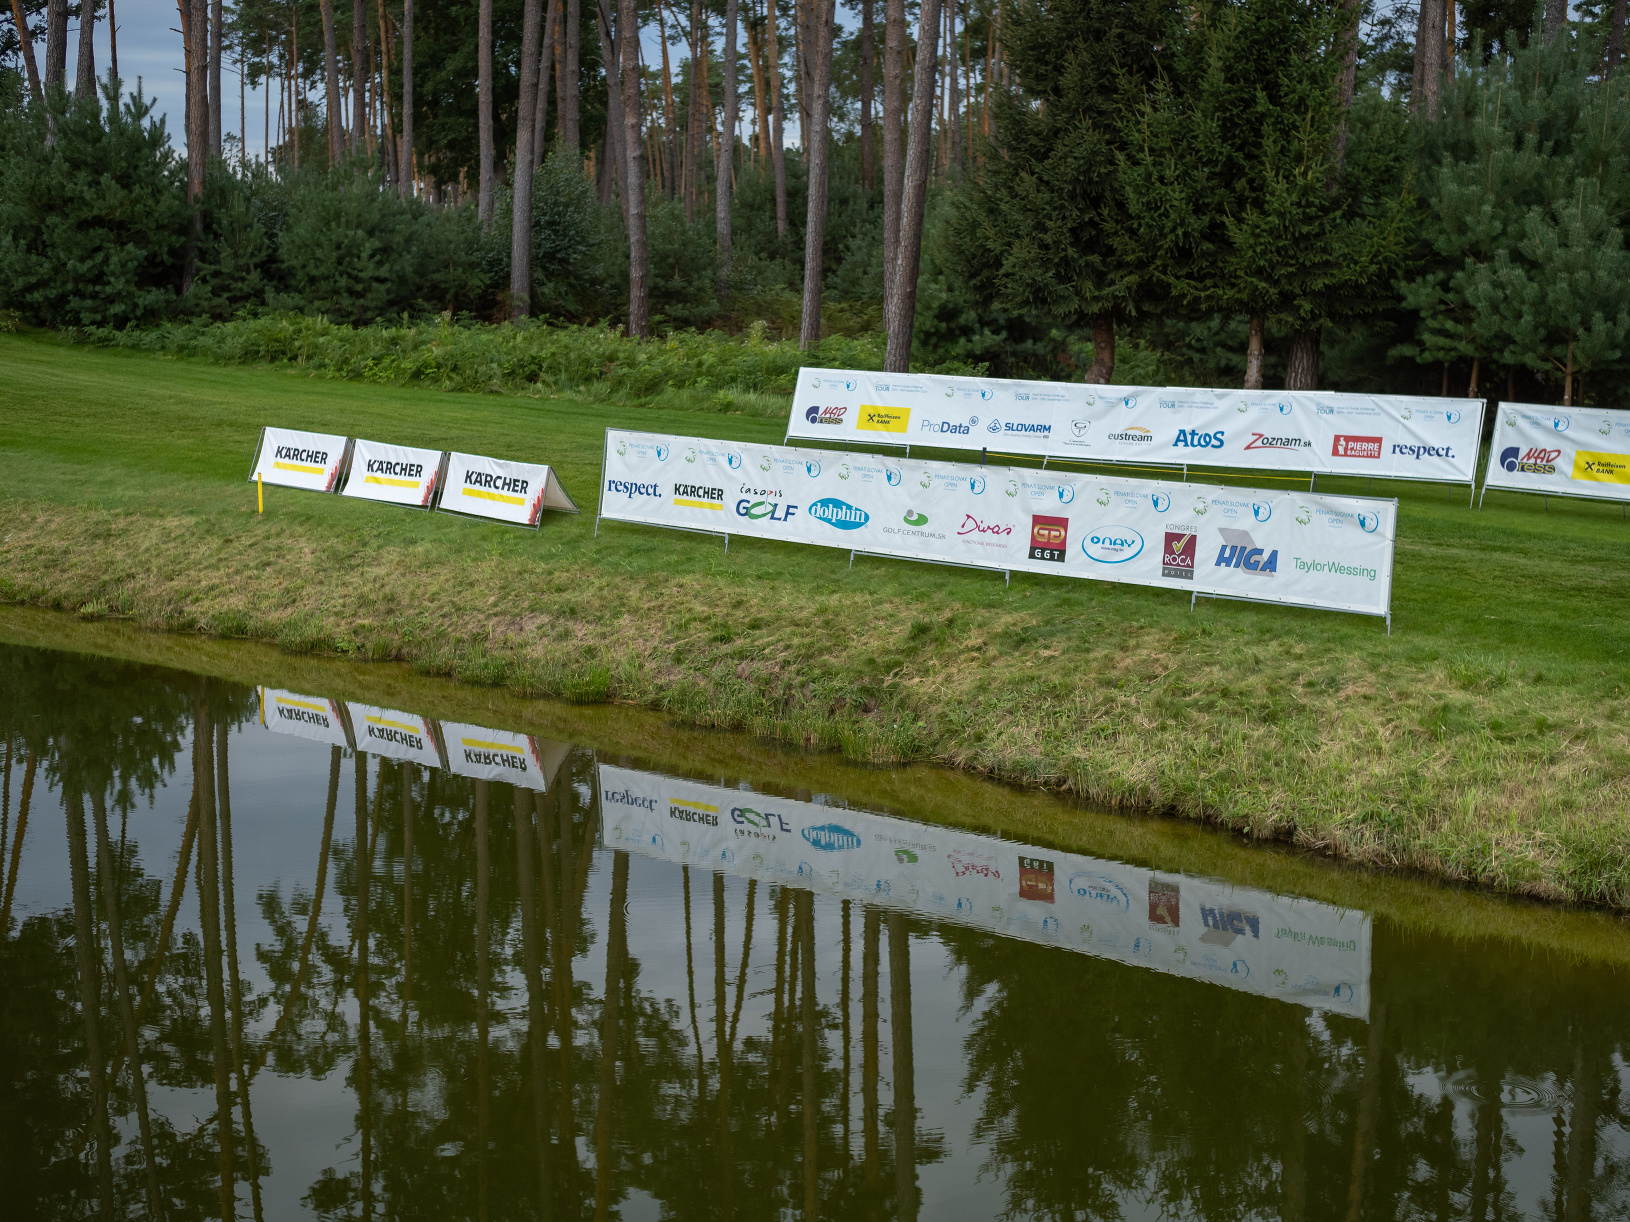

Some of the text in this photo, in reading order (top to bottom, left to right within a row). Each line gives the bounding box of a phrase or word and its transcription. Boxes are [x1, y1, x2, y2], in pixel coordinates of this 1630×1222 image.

[921, 419, 970, 435] ProData
[1004, 423, 1051, 434] SLOVARM
[1108, 432, 1153, 442] eustream
[1244, 432, 1312, 451] Zoznam.sk
[1347, 441, 1380, 452] PIERRE
[1391, 443, 1455, 460] respect.
[275, 446, 328, 465] KÄRCHER
[367, 459, 423, 478] KÄRCHER
[1597, 461, 1626, 470] Raiffeisen
[464, 470, 529, 494] KÄRCHER
[607, 479, 662, 499] respect.
[674, 483, 724, 501] KÄRCHER
[736, 499, 798, 522] GOLF
[811, 503, 865, 523] dolphin
[1165, 523, 1198, 533] KONGRES
[1164, 554, 1192, 567] ROCA
[1214, 544, 1279, 573] HIGA
[1164, 569, 1192, 577] HOTEL
